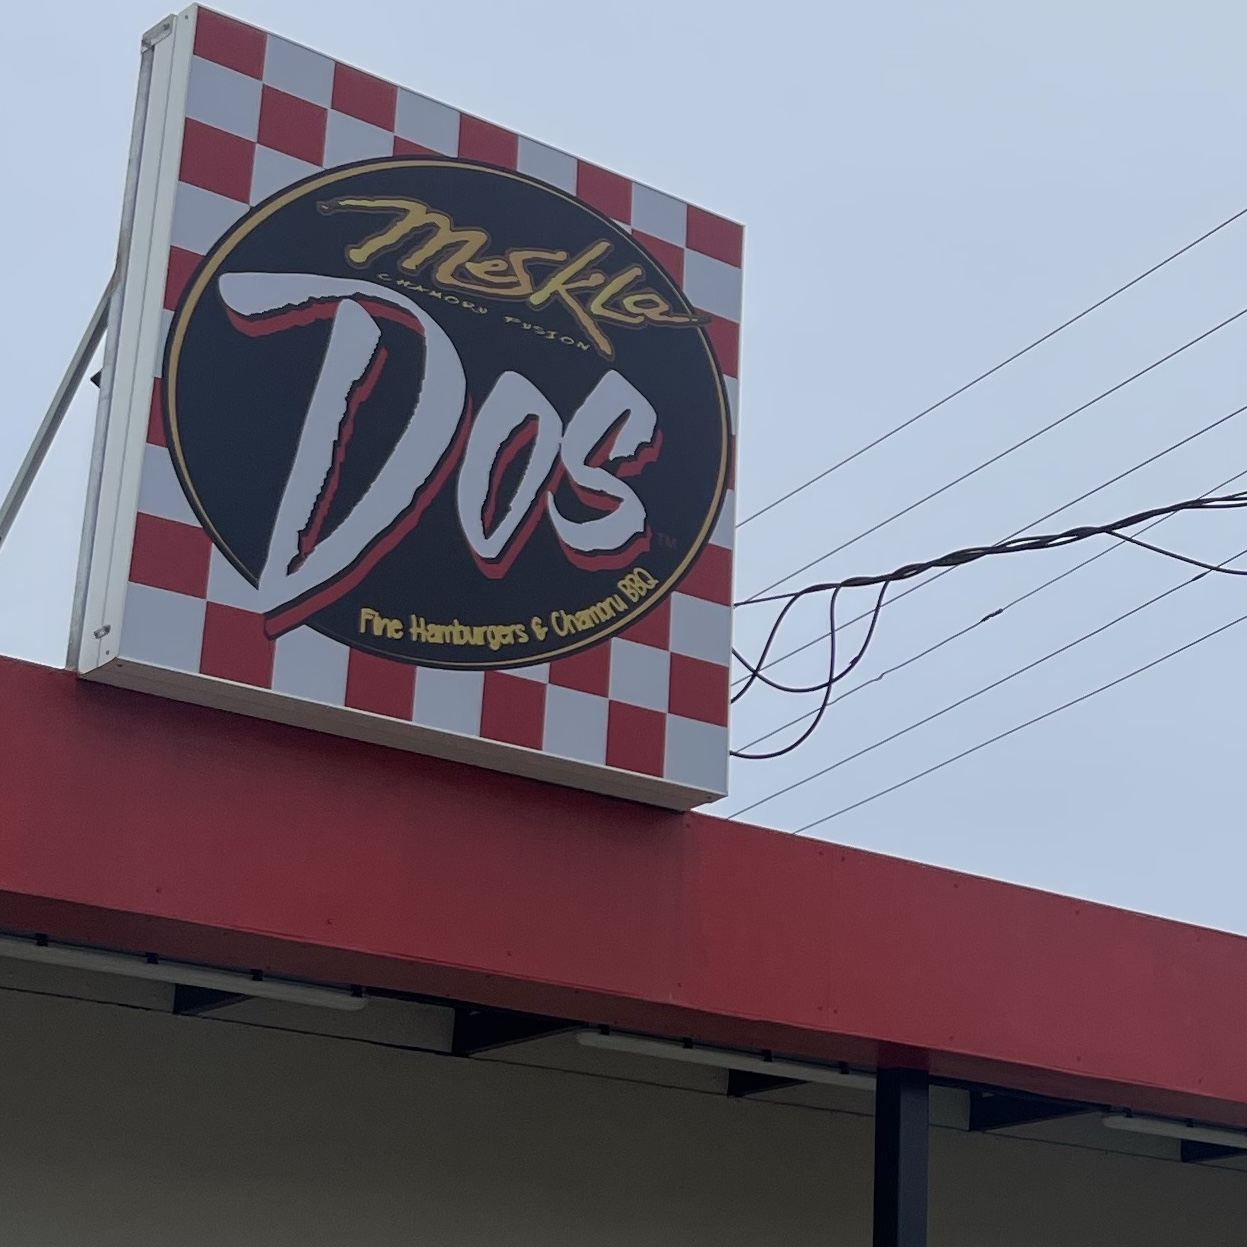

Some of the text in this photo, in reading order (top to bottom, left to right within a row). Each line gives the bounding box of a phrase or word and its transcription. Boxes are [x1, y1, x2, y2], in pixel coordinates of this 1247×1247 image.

[318, 197, 706, 358] Meskla
[504, 316, 590, 350] FUSION
[360, 608, 403, 639] Fine
[409, 614, 530, 651] Hamburgers
[531, 617, 548, 641] &
[617, 567, 660, 603] BBQ
